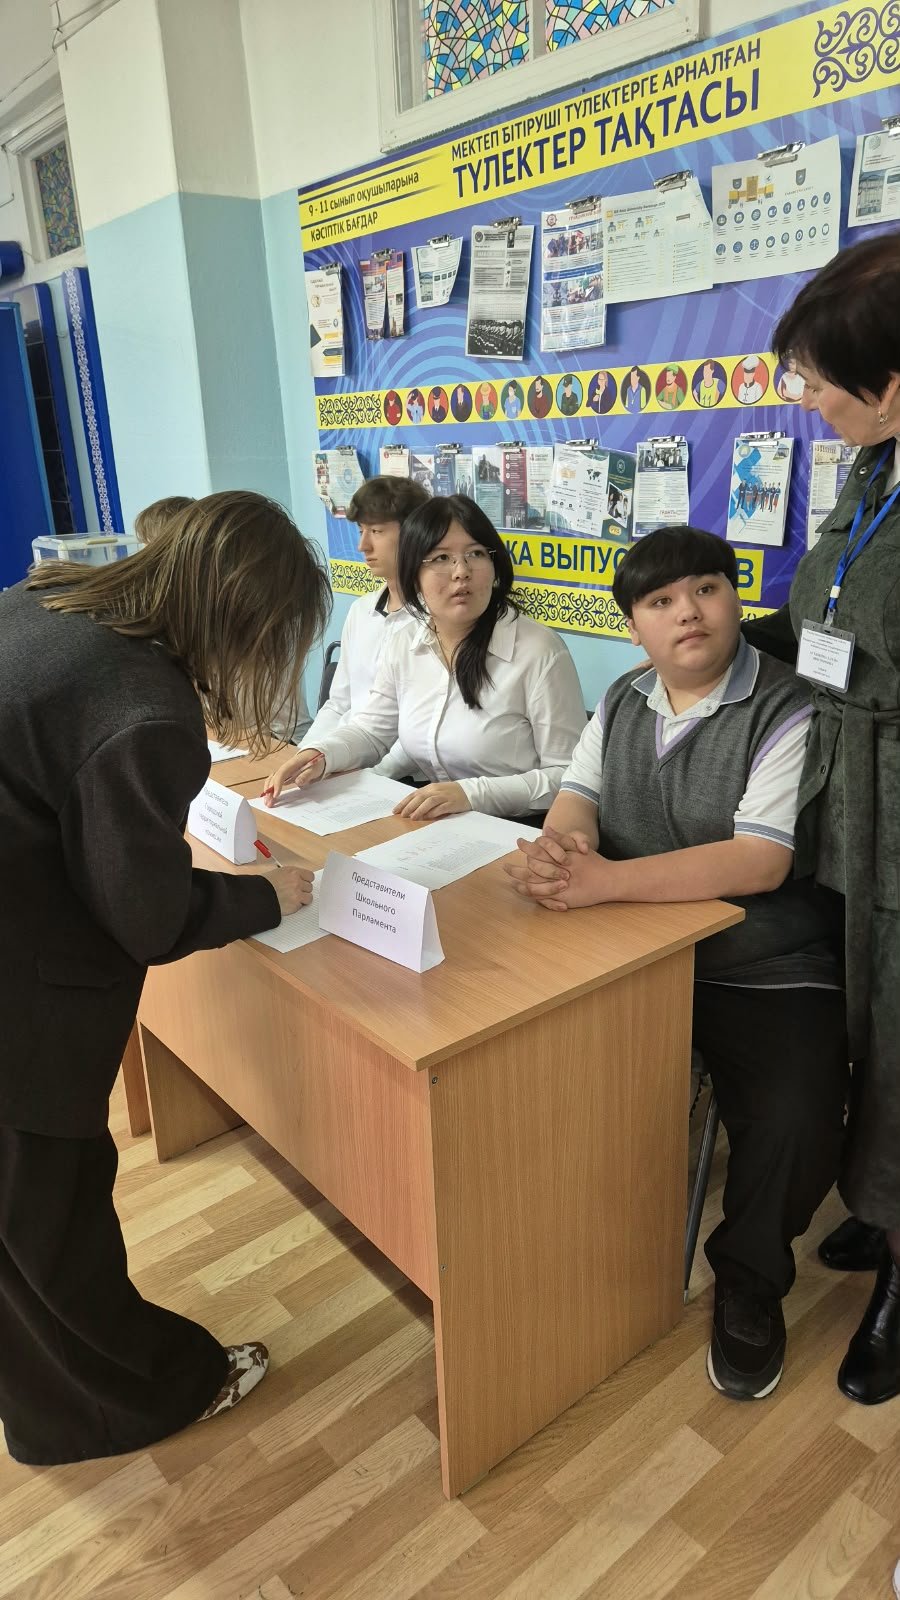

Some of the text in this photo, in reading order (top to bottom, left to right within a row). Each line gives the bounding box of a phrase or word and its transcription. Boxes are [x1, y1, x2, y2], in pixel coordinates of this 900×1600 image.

[451, 37, 761, 161] МЕКТЕП БІТІРУШІ ТҮЛЕКТЕРГЕ АРНАЛҒАН
[452, 68, 760, 198] ТҮЛЕКТЕР ТАҚТАСЫ
[308, 204, 314, 217] 9
[319, 202, 329, 214] 11
[329, 192, 356, 211] сынып
[356, 171, 419, 201] оқушыларына
[310, 211, 379, 242] КӘСІПТІК БАҒДАР
[351, 871, 406, 901] Представители
[355, 891, 396, 916] Школьного
[352, 908, 397, 934] Парламента
